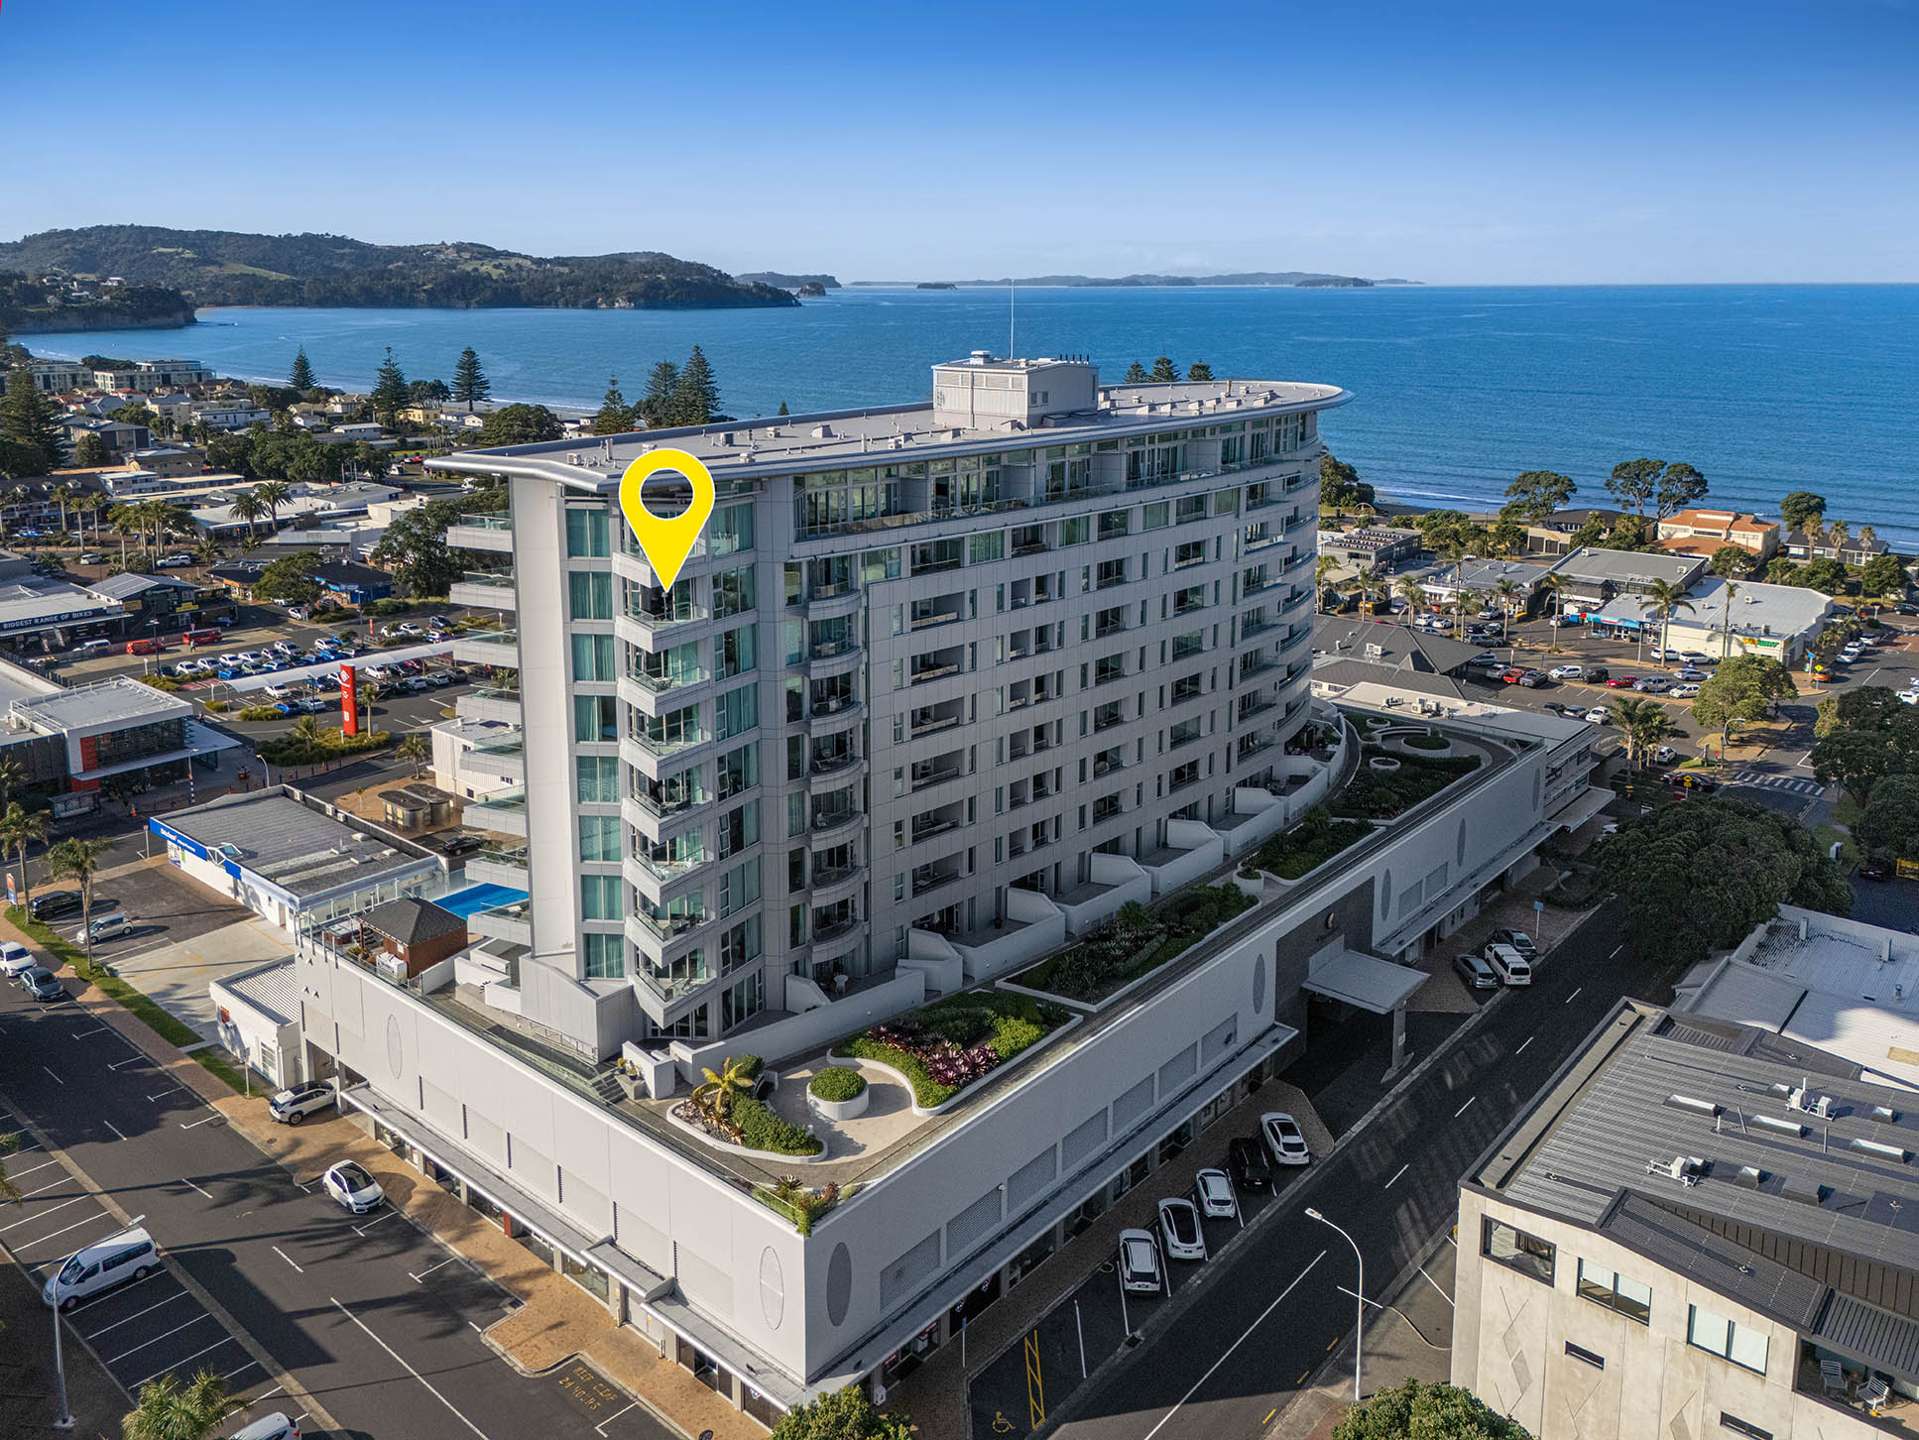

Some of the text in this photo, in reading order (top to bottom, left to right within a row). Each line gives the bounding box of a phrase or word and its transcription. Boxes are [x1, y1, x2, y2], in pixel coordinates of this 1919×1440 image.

[3, 619, 32, 630] BIGGEST
[34, 616, 58, 625] RANGE
[72, 611, 93, 619] BIKES
